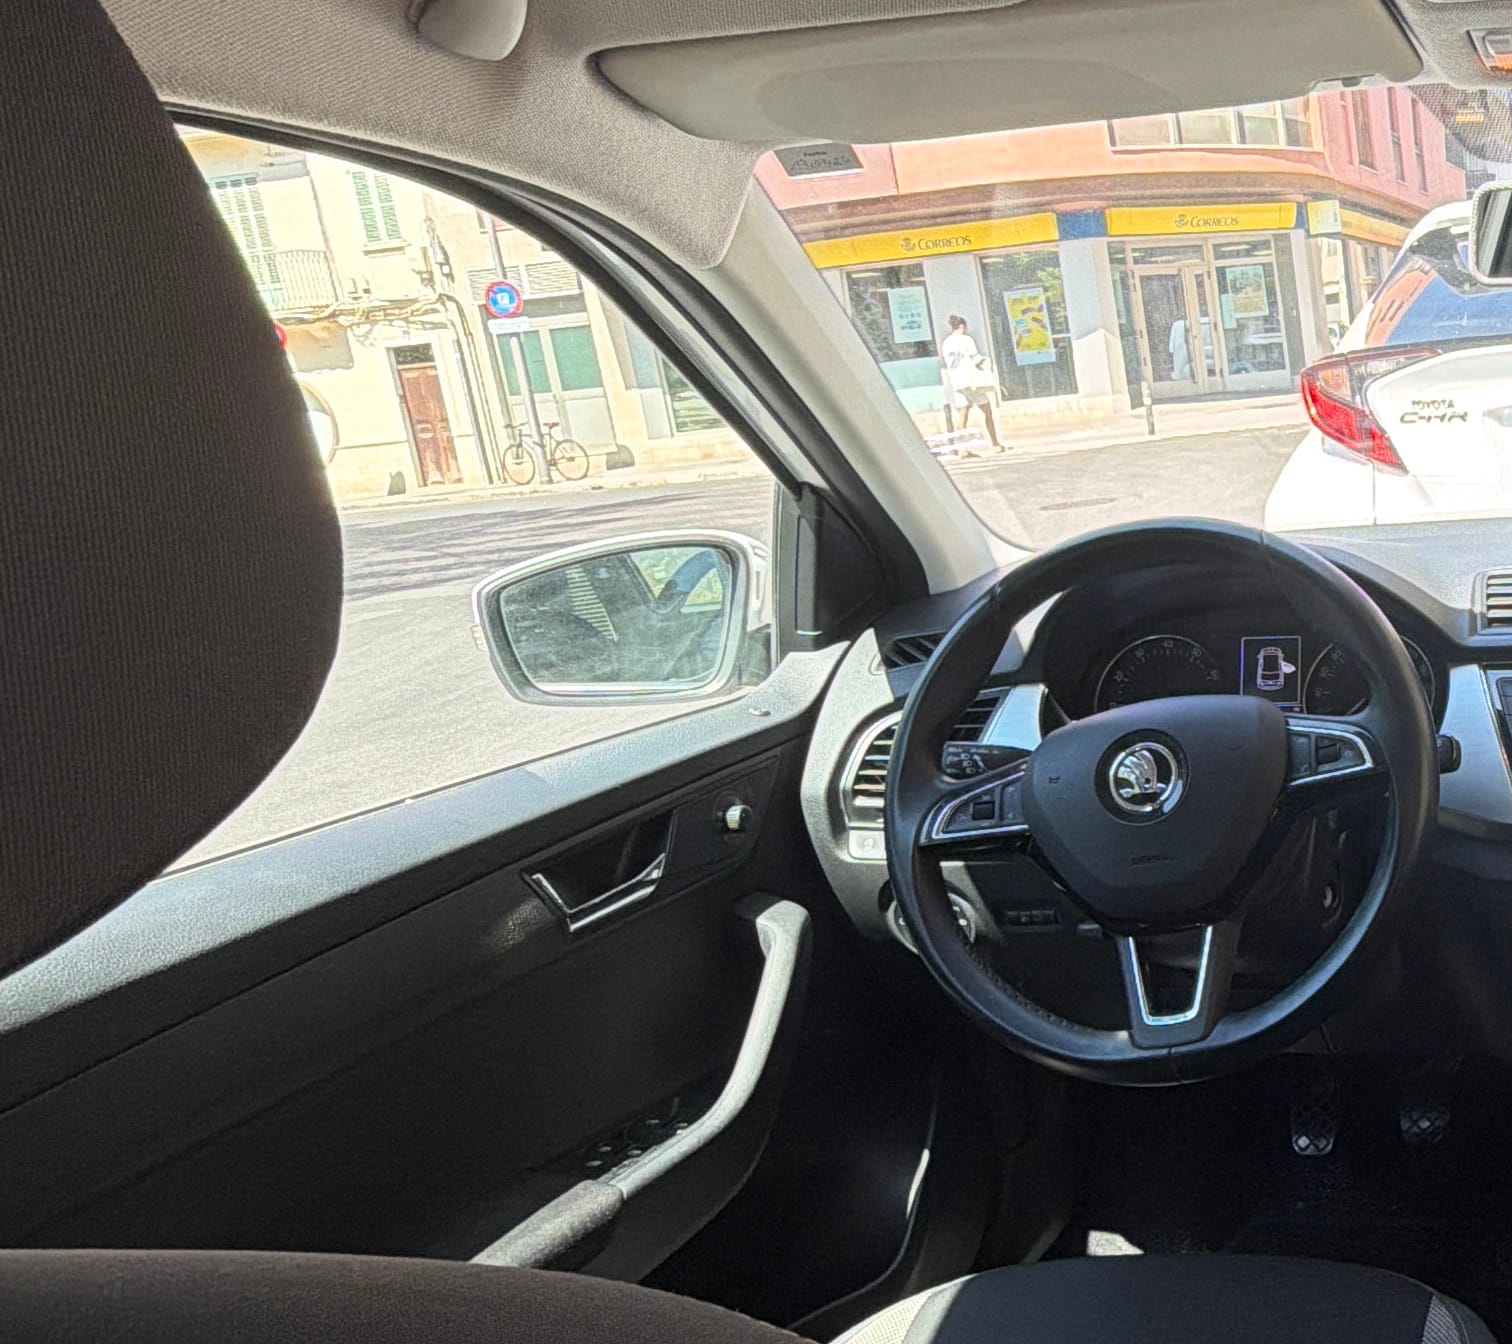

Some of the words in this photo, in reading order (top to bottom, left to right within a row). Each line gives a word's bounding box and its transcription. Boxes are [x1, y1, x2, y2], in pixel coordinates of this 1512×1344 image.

[1190, 216, 1239, 228] CORREOS
[917, 235, 972, 251] CORREOS
[1411, 399, 1454, 410] TOYOTA
[1400, 412, 1468, 424] C-HR
